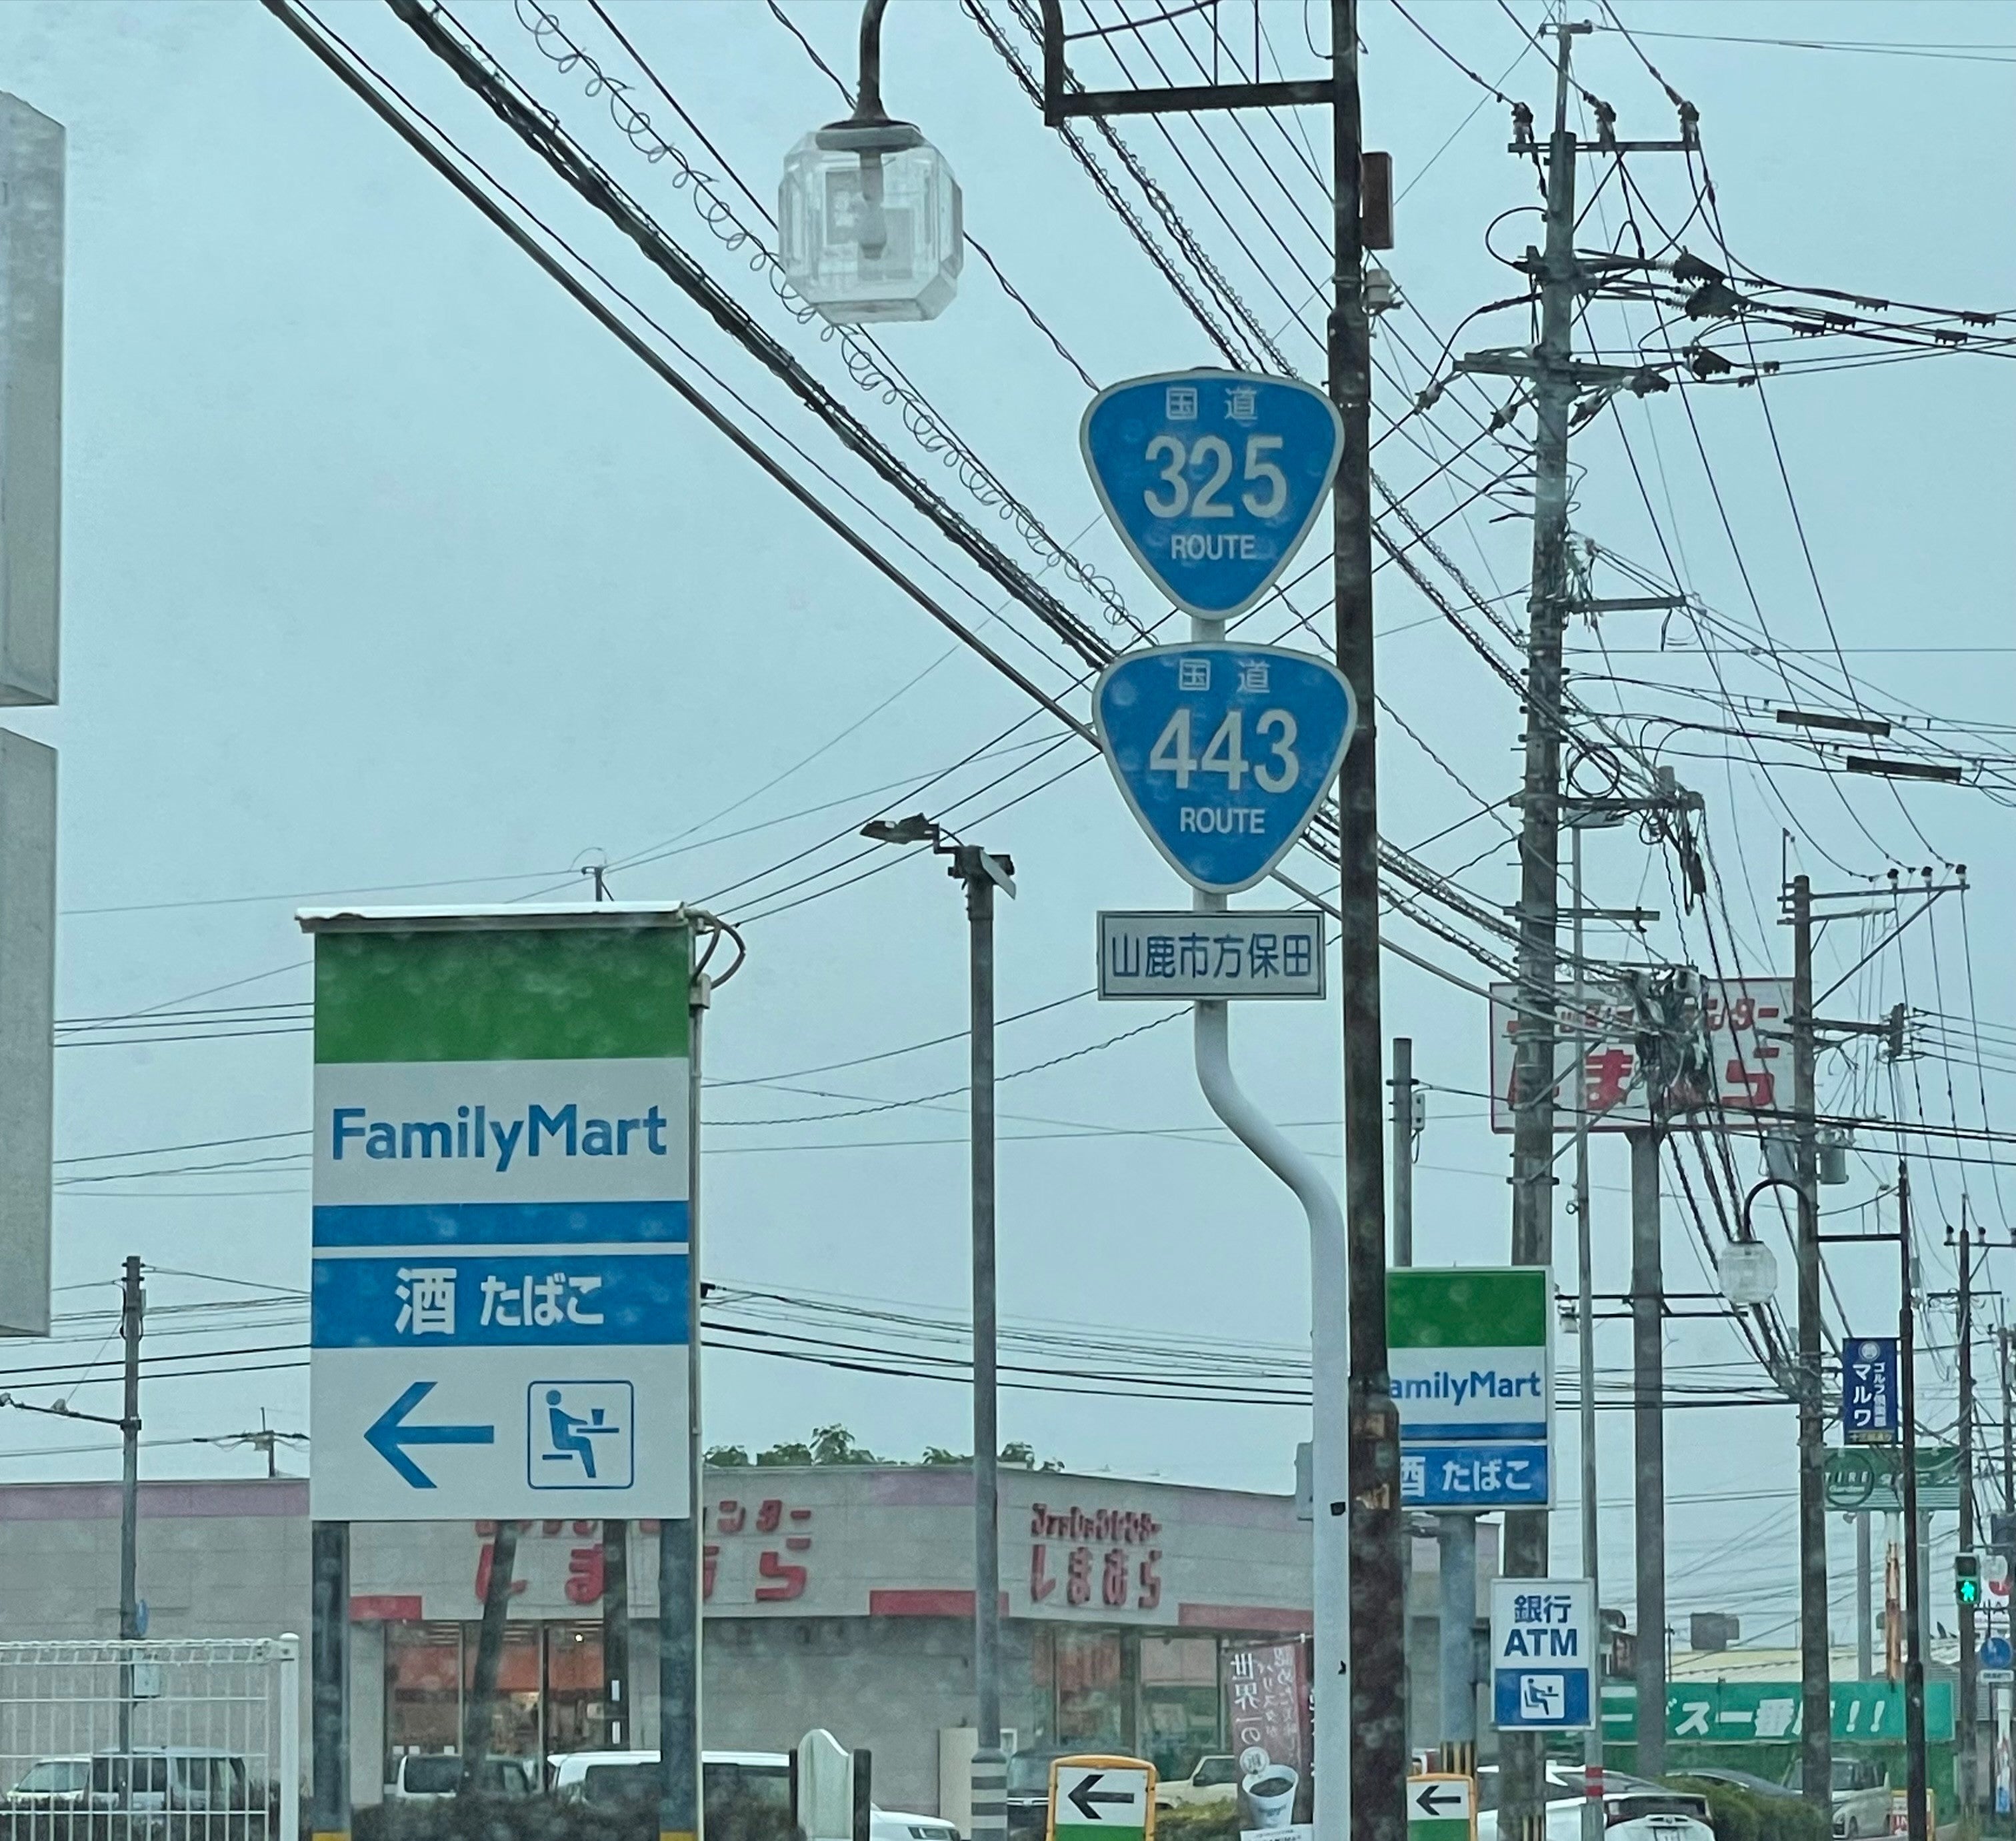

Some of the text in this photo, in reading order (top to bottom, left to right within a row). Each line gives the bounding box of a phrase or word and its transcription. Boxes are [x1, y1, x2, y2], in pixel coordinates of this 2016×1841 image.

[1166, 387, 1258, 421] 国道
[1144, 435, 1287, 518] 325
[1171, 535, 1255, 559] ROUTE
[1179, 658, 1270, 693] 国道
[1150, 709, 1299, 793] 443
[1180, 807, 1265, 834] ROUTE
[1112, 932, 1311, 978] 山鹿市方保田
[333, 1103, 667, 1172] FamilyMart
[395, 1267, 604, 1335] 酒 たばこ
[1390, 1370, 1541, 1406] amilyMart
[1853, 1364, 1872, 1426] マルワ
[1442, 1458, 1532, 1492] たばこ
[1514, 1594, 1572, 1624] 銀行
[1503, 1628, 1578, 1657] ATM
